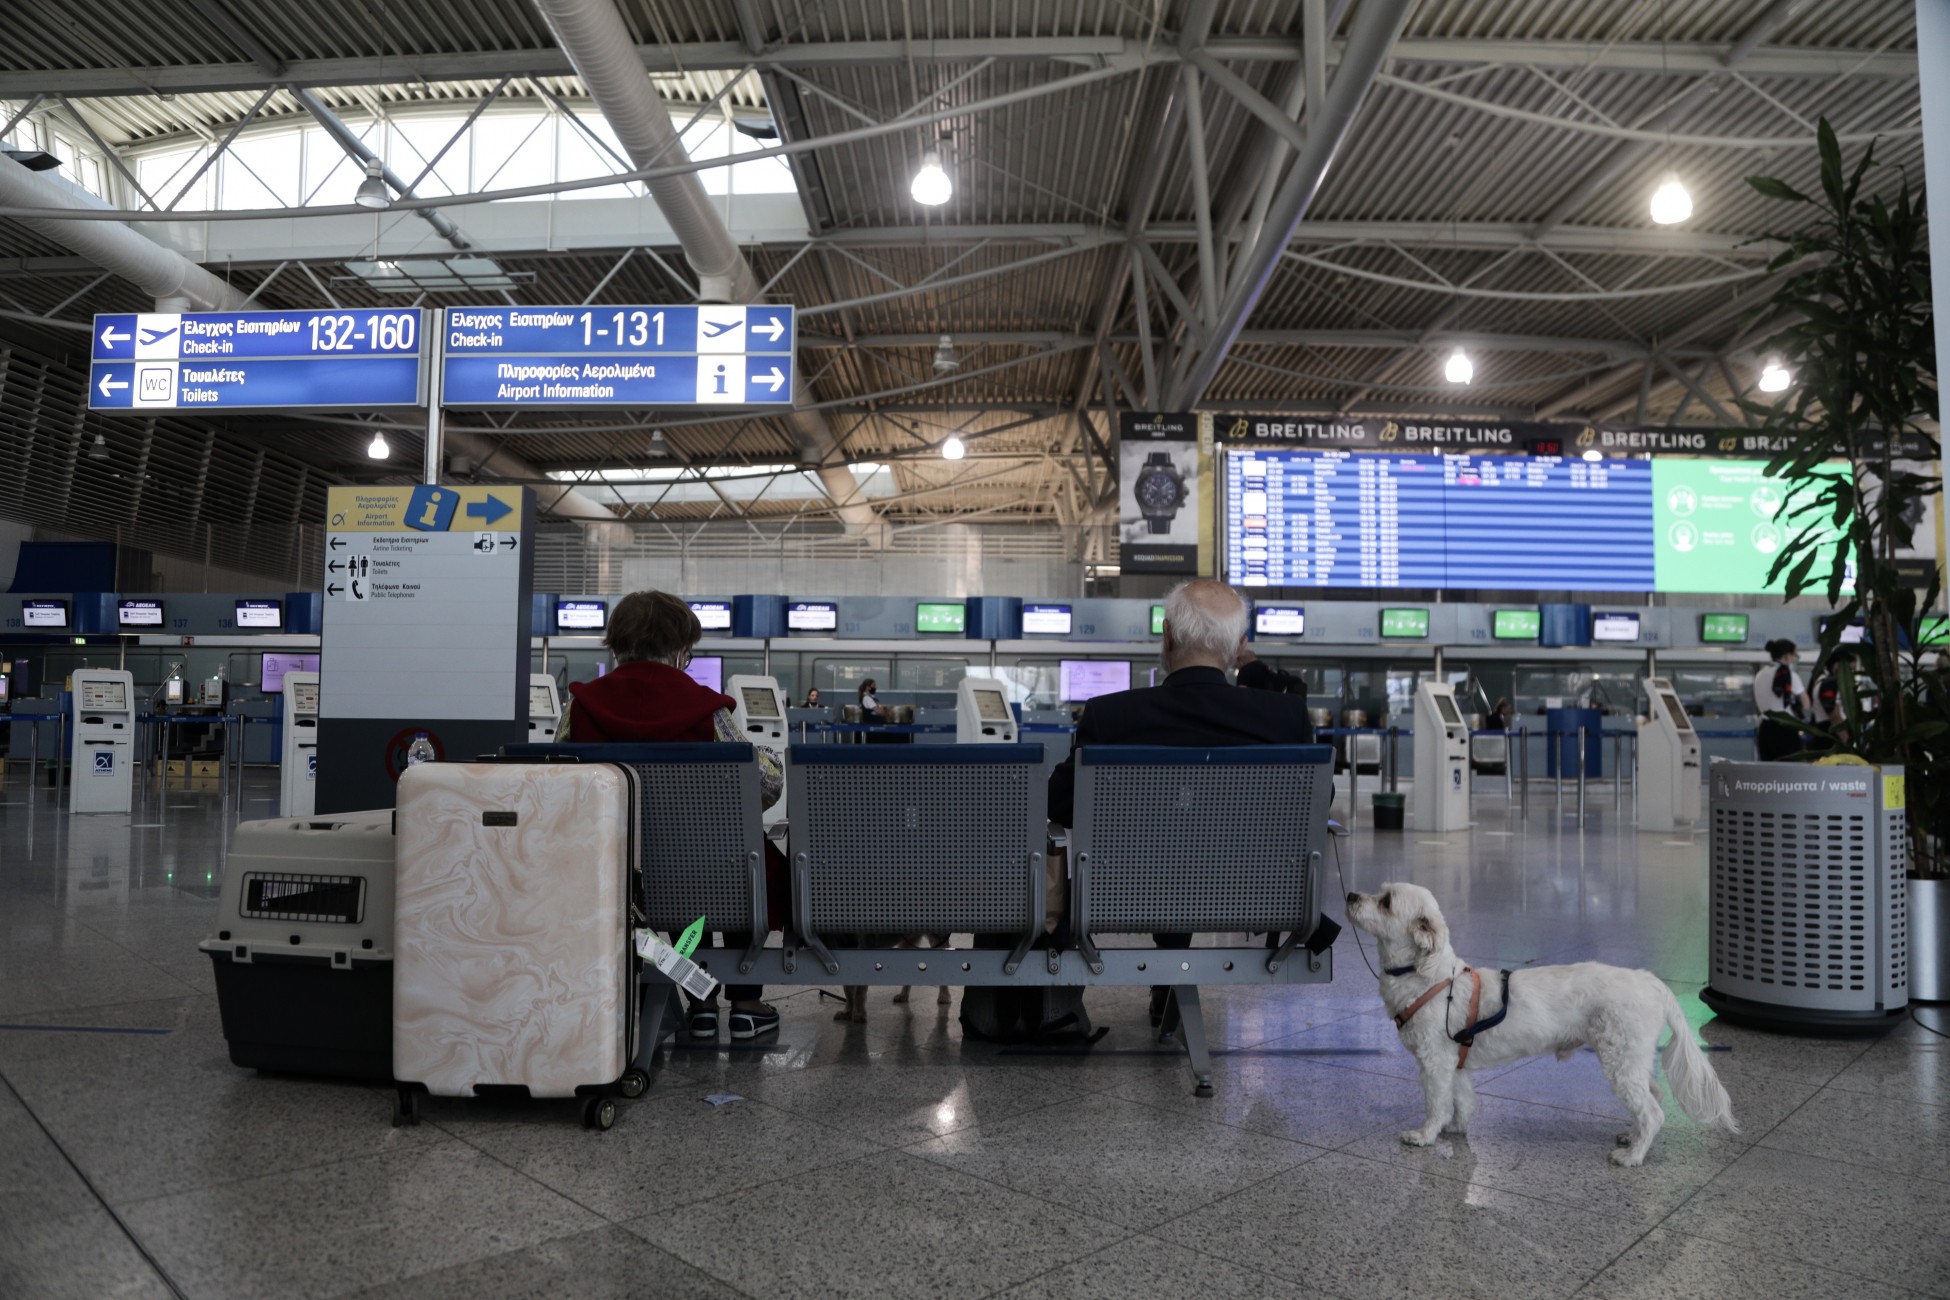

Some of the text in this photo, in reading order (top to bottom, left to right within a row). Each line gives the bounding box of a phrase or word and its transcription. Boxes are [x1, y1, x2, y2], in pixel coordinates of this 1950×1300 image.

[236, 319, 300, 336] Εισιτηρίων
[509, 313, 574, 328] Εισιτηρίων
[307, 313, 415, 350] 132-160
[579, 311, 665, 346] 1-131
[183, 339, 233, 354] Check-in
[450, 333, 503, 347] Check-in
[183, 368, 245, 385] Τουαλέτες
[498, 363, 655, 380] Πληροφορίες Αερολιμένα
[145, 378, 167, 392] WC
[498, 384, 614, 401] Airport Information
[182, 388, 218, 403] Toilets
[1134, 423, 1183, 432] BREITLING
[1255, 422, 1365, 440] BREITLING
[1405, 425, 1513, 443] BREITLING
[1601, 431, 1706, 449] BREITLING
[355, 496, 400, 504] Πληροφορίες
[365, 513, 388, 521] Airport
[373, 560, 400, 568] Τουαλέτες
[387, 591, 415, 599] Telephones
[5, 618, 21, 628] 138
[173, 618, 188, 628] 137
[218, 618, 233, 628] 136
[1079, 624, 1096, 634] 129
[1734, 779, 1818, 794] Απορρίμματα
[1829, 780, 1867, 791] waste
[680, 930, 697, 954] RANSFER
